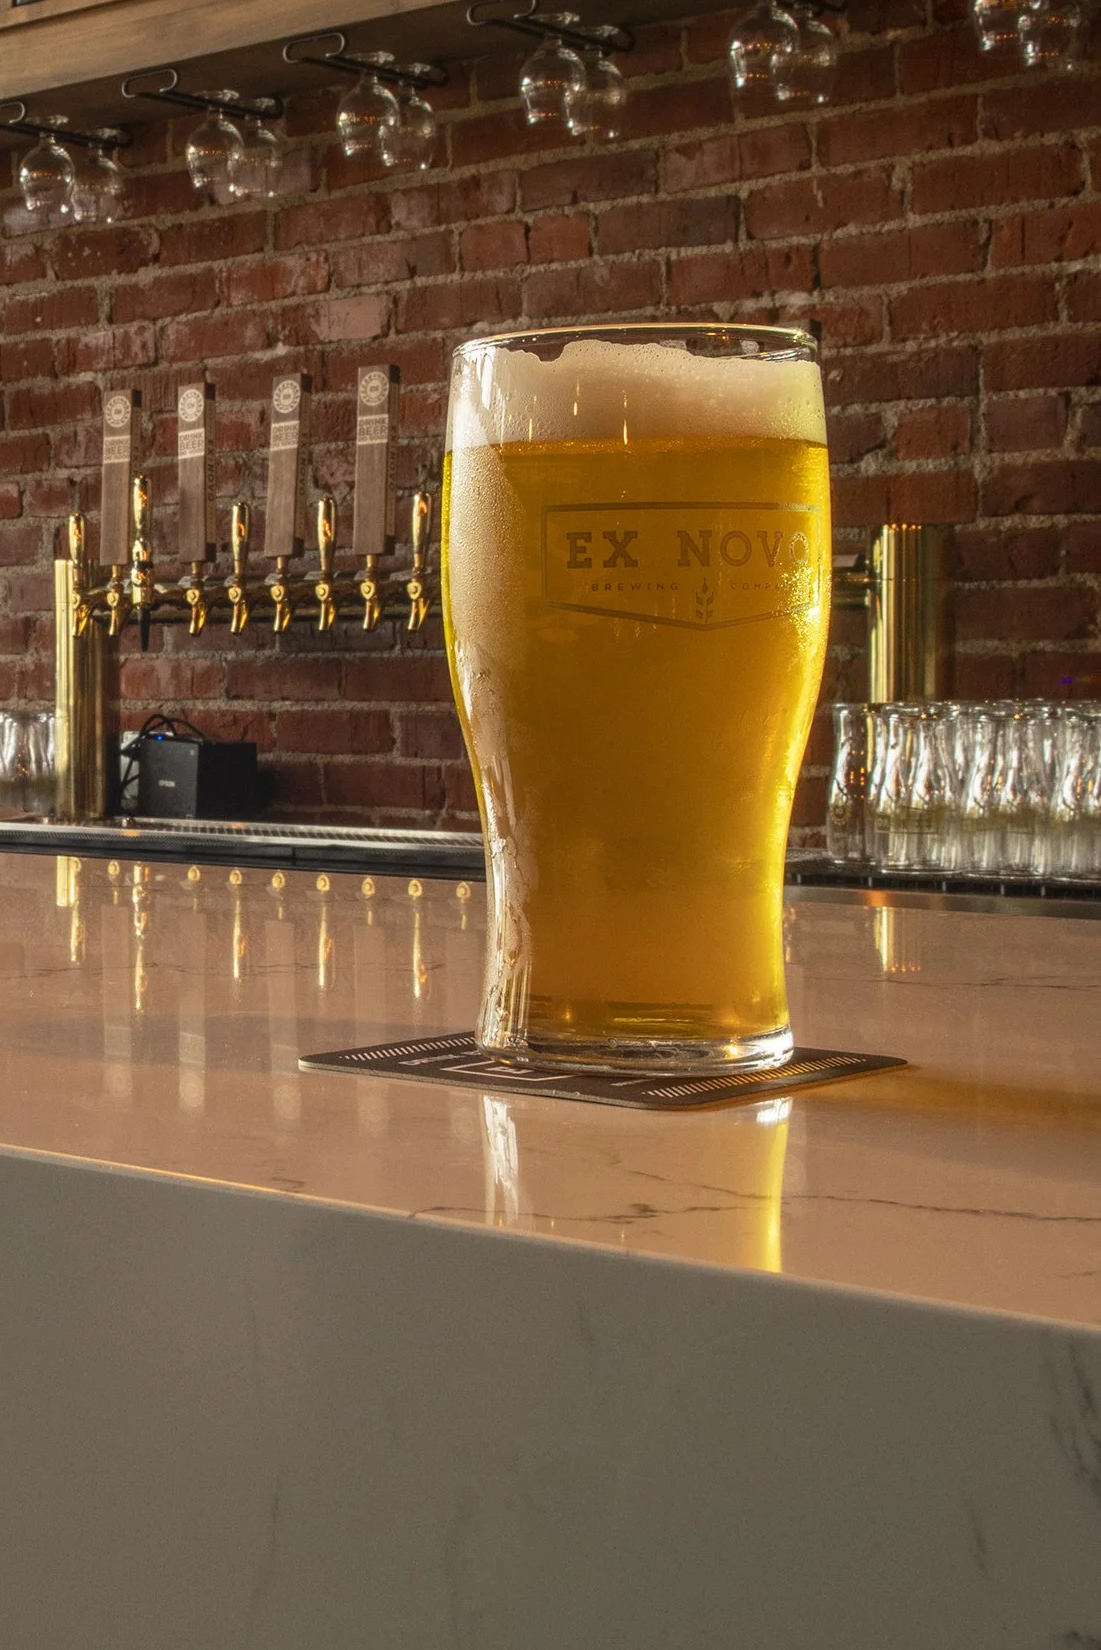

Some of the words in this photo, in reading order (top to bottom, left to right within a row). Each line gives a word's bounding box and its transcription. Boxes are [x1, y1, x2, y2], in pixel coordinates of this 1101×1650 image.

[565, 530, 639, 569] EX
[676, 530, 810, 569] NOVO
[591, 581, 678, 592] BREWING
